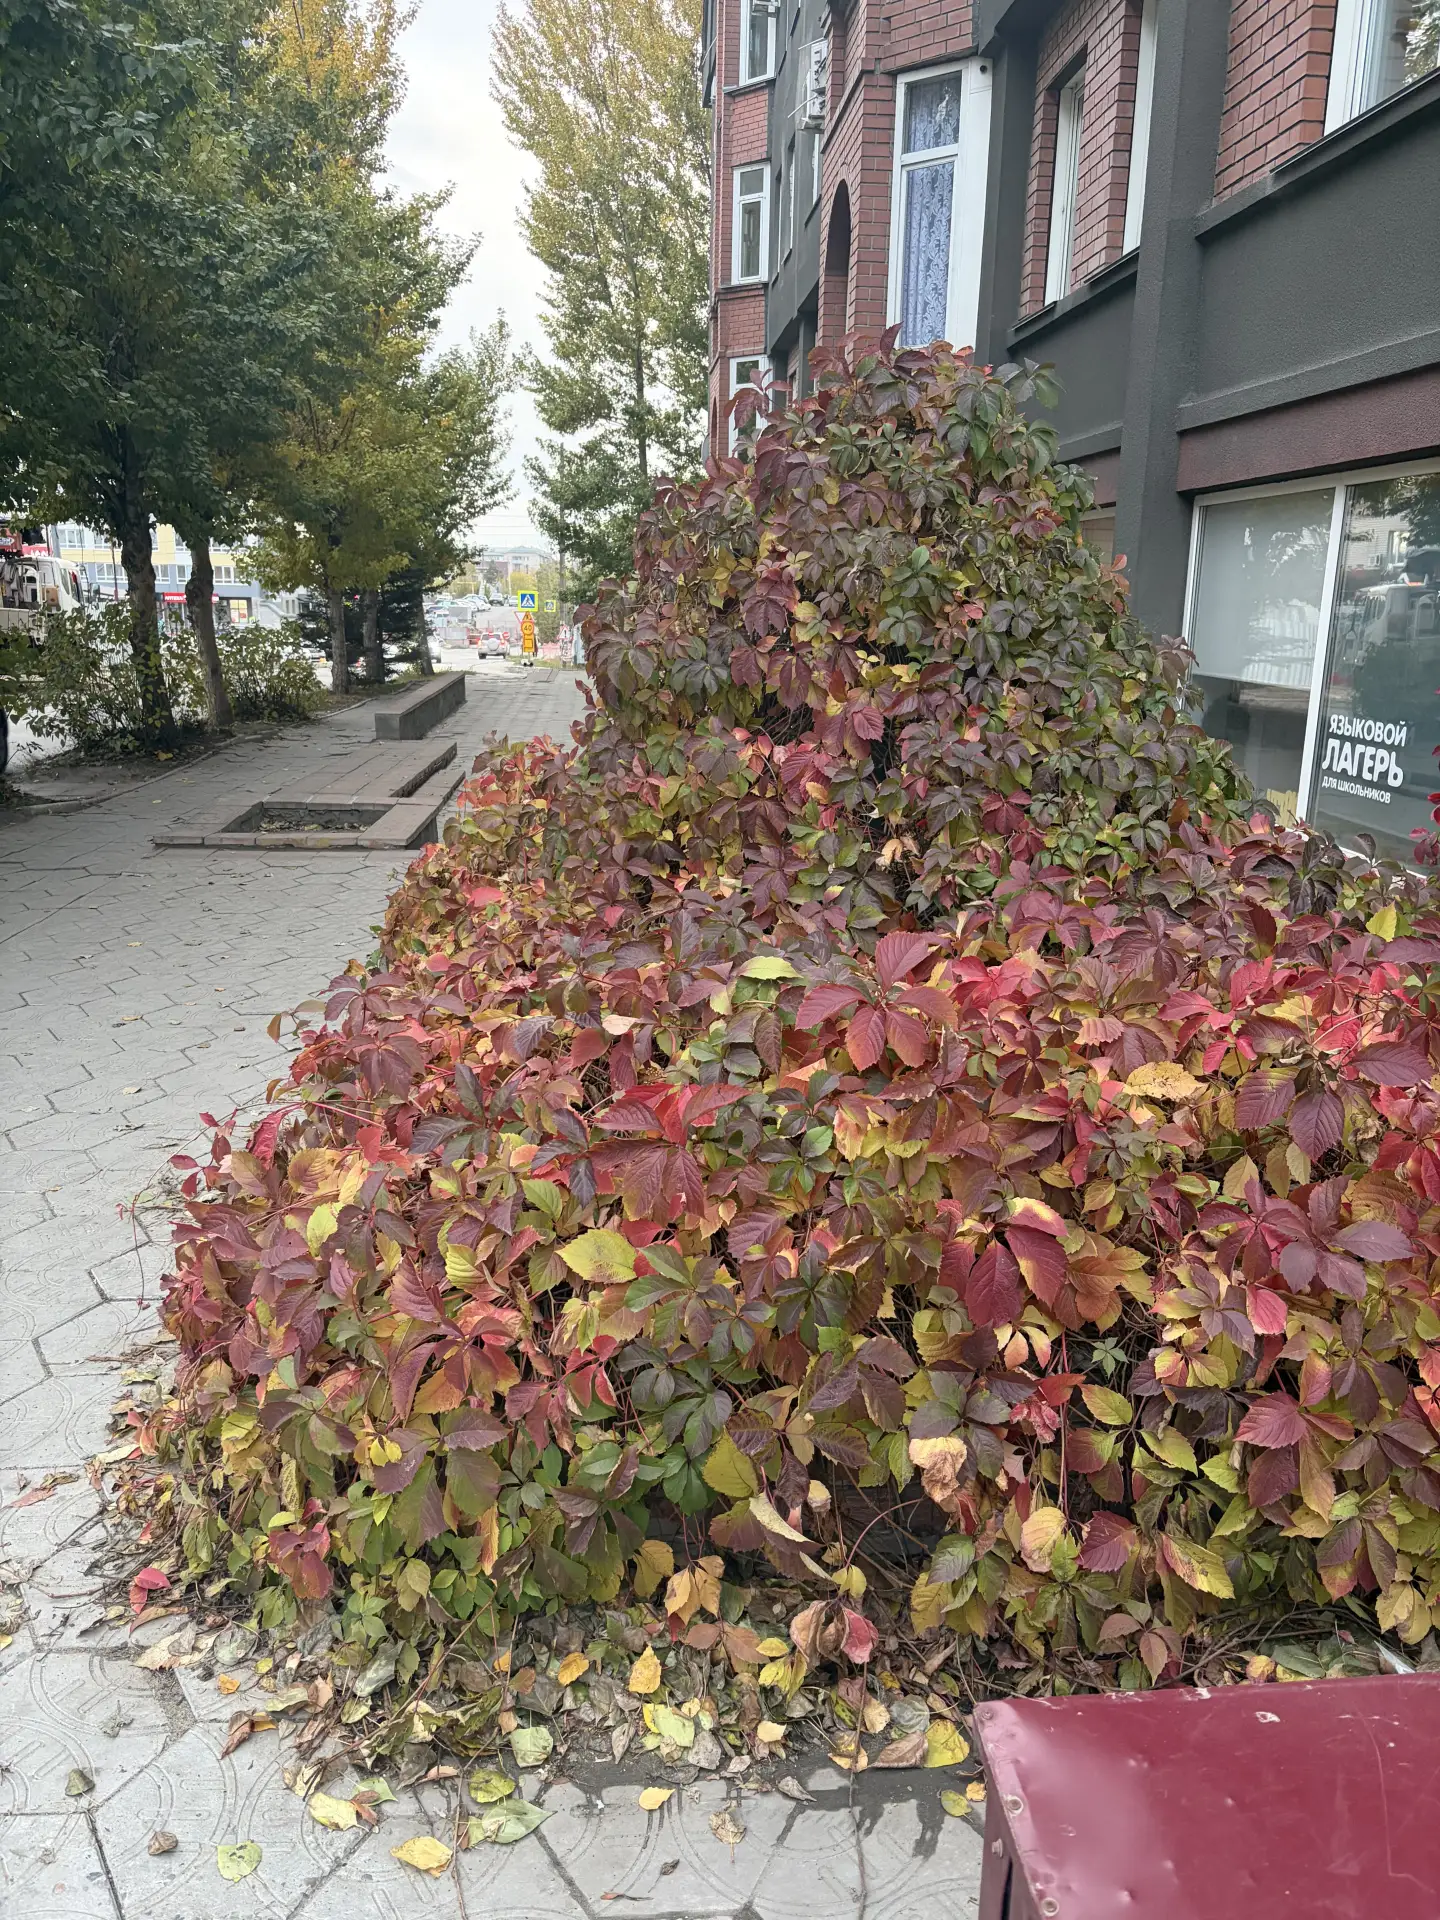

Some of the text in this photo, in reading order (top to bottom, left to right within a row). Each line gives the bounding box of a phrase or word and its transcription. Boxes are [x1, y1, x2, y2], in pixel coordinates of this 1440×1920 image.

[1329, 714, 1407, 747] ЯЗЫКОВОЙ
[1322, 738, 1404, 788] ЛАГЕРЬ
[1322, 776, 1391, 804] ДЛЯ ШКОЛЬНИКОВ
